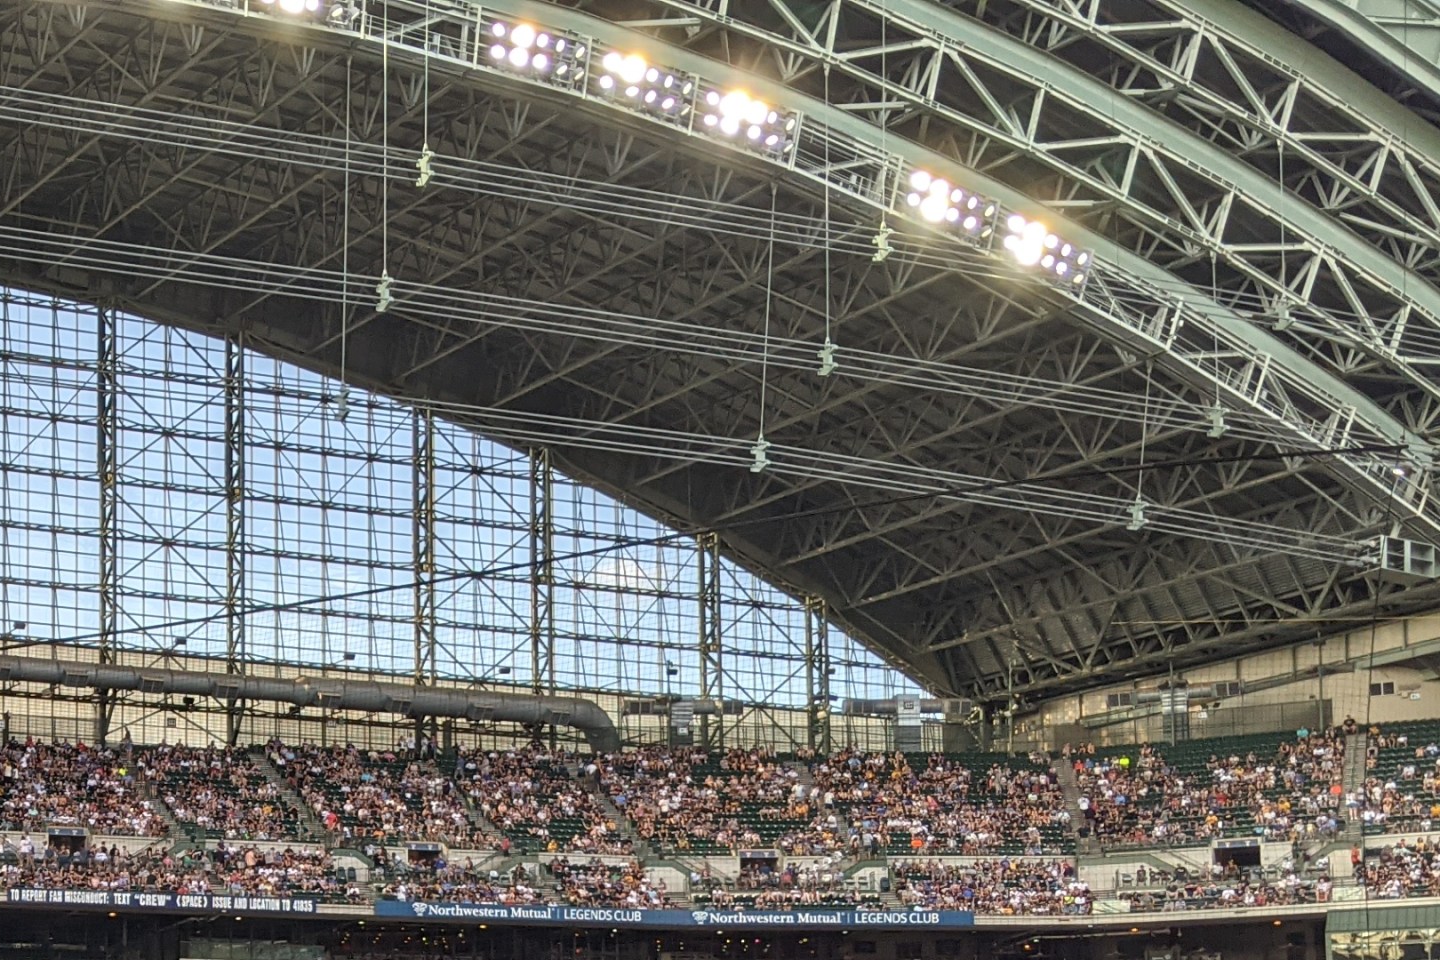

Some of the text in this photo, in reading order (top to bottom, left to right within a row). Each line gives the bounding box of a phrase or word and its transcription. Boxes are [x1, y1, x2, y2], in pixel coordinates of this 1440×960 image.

[10, 889, 19, 901] TO
[21, 889, 47, 902] REPORT
[49, 890, 63, 903] FAN
[64, 891, 110, 904] MISCONDUCT:
[113, 892, 131, 905] TEXT
[212, 896, 232, 909] ISSUE
[233, 897, 247, 910] AND
[249, 898, 280, 911] LOCATION
[282, 899, 291, 911] TO
[292, 900, 313, 912] 41835
[428, 903, 552, 919] Northwestern Mutual
[564, 908, 642, 922] LEGENDS CLUB
[710, 911, 842, 924] Northwestern Mutual
[854, 912, 939, 924] LEGENDS CLUB
